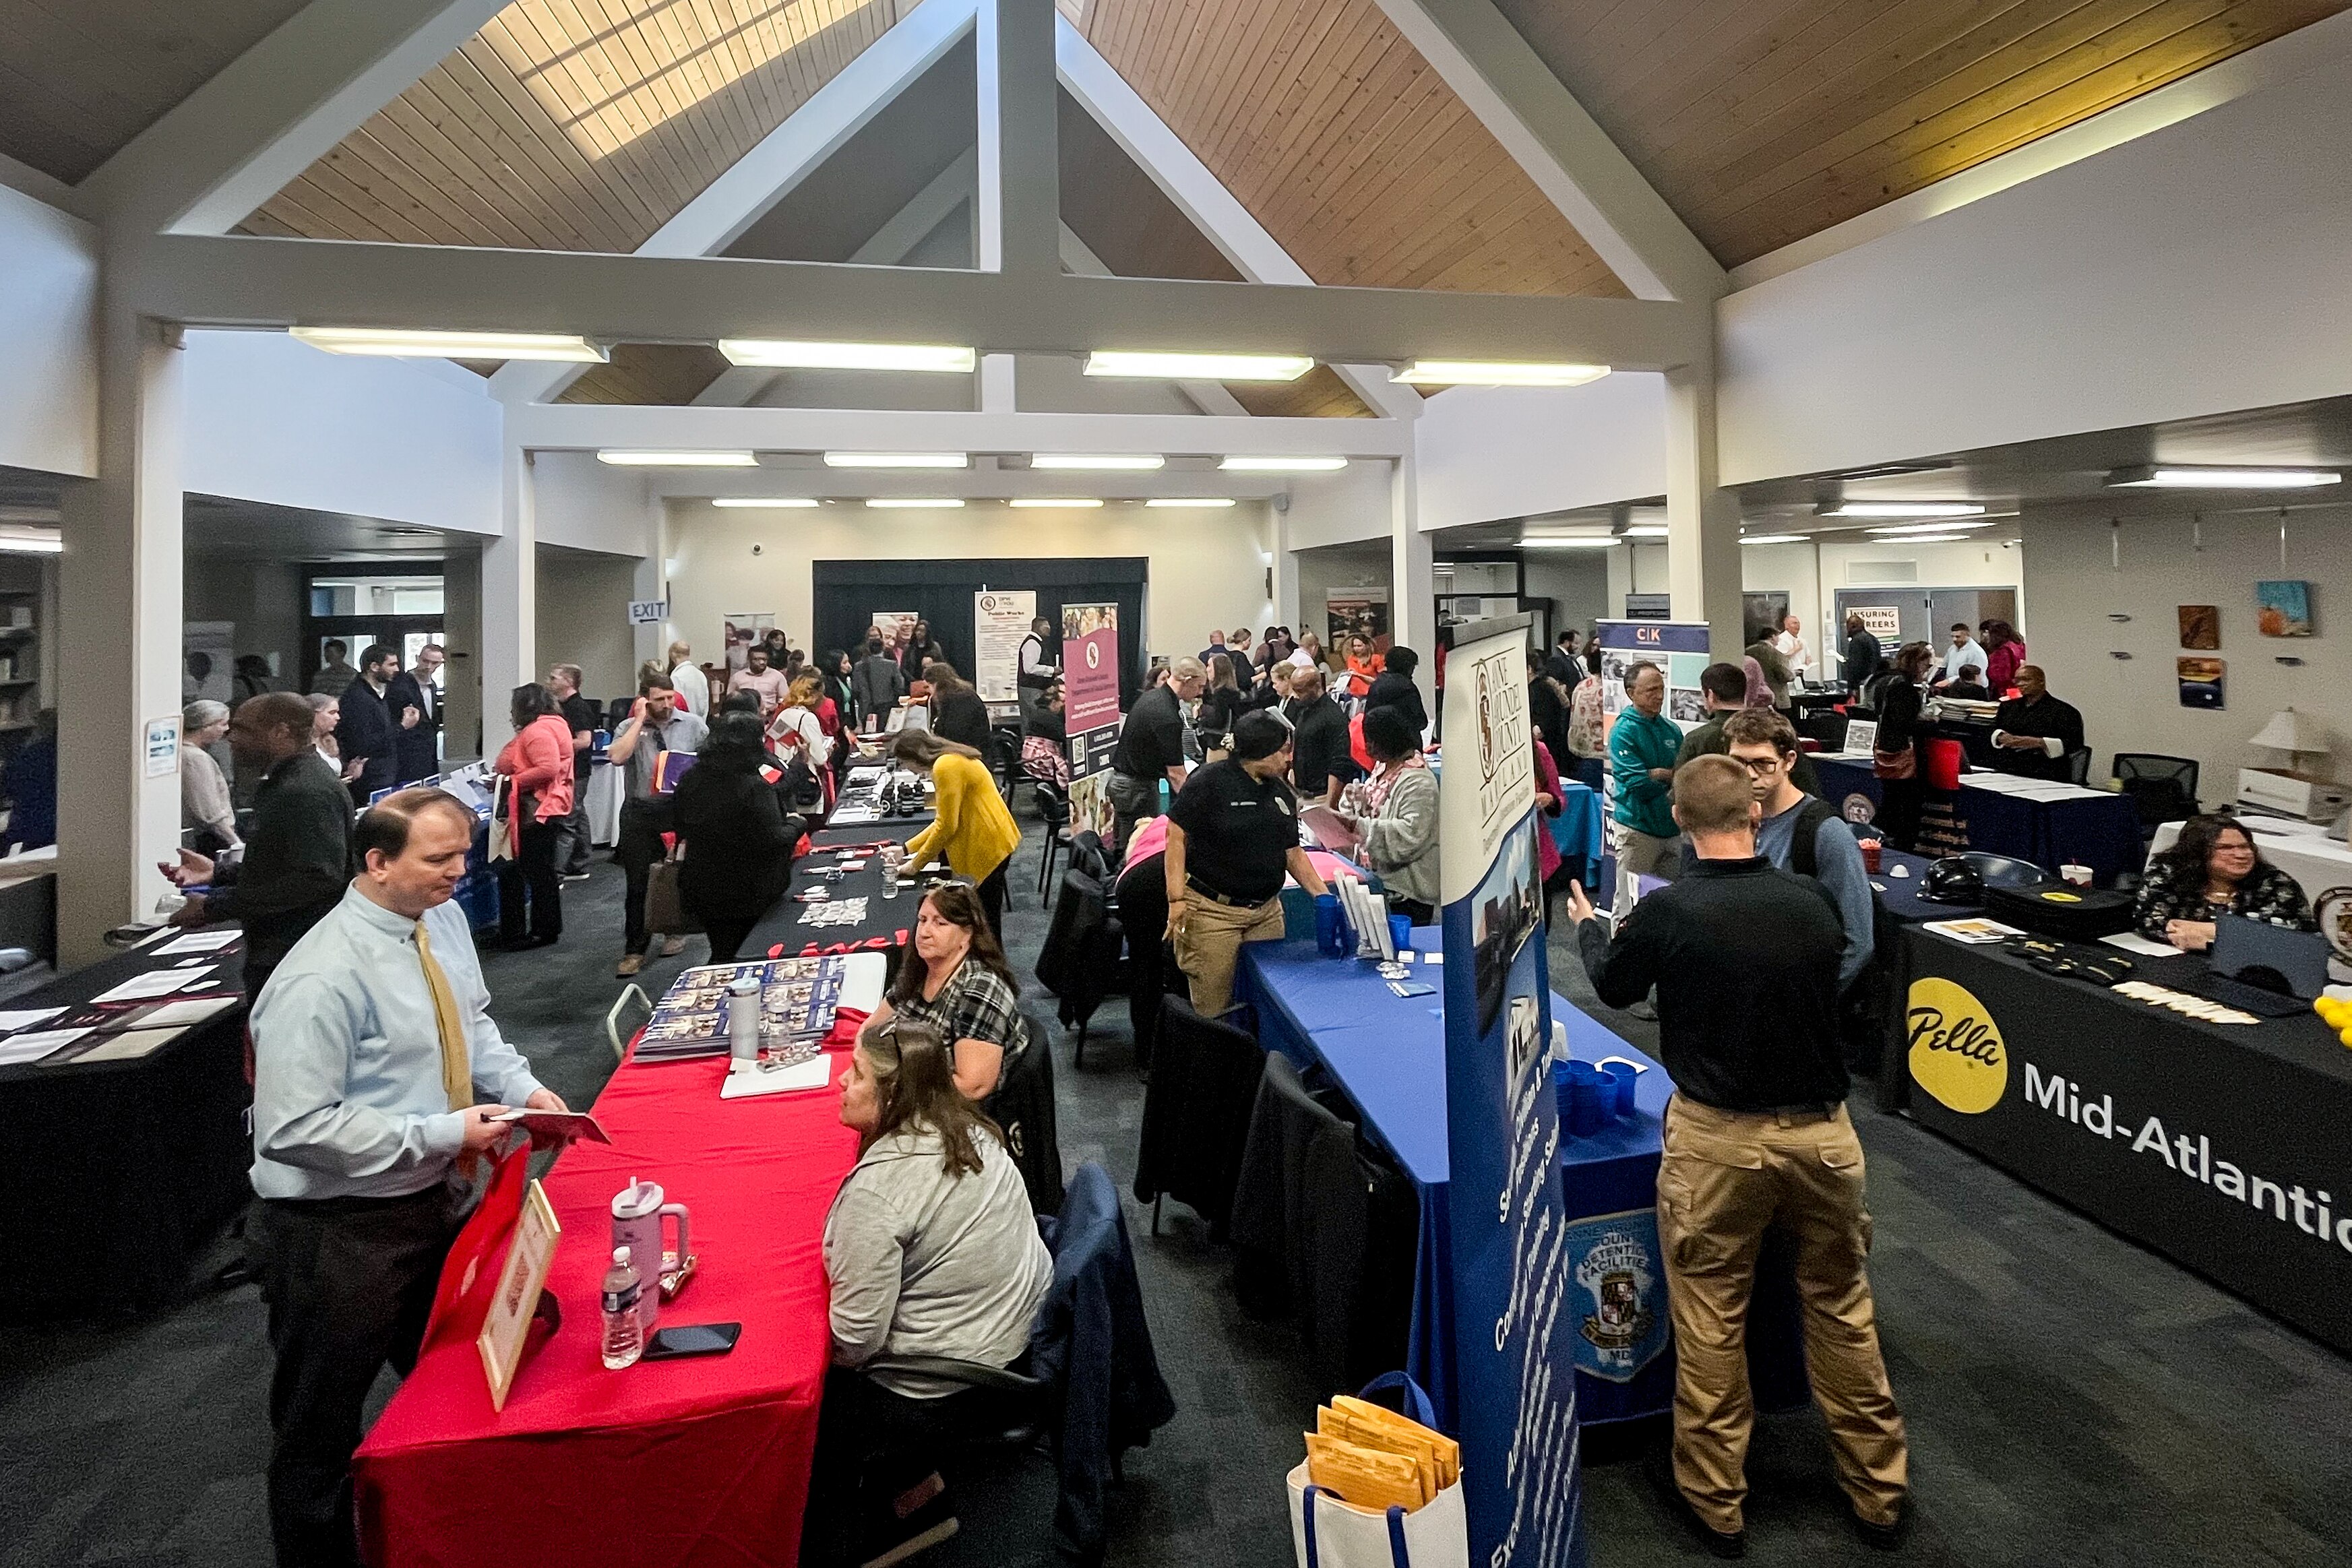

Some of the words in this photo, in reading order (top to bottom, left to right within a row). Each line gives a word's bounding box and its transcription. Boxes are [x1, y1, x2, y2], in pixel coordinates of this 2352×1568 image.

[633, 602, 665, 617] EXIT
[1909, 1007, 1999, 1066] Pella
[1581, 1244, 1645, 1269] DETENTIO
[1581, 1256, 1646, 1282] FACILITIE
